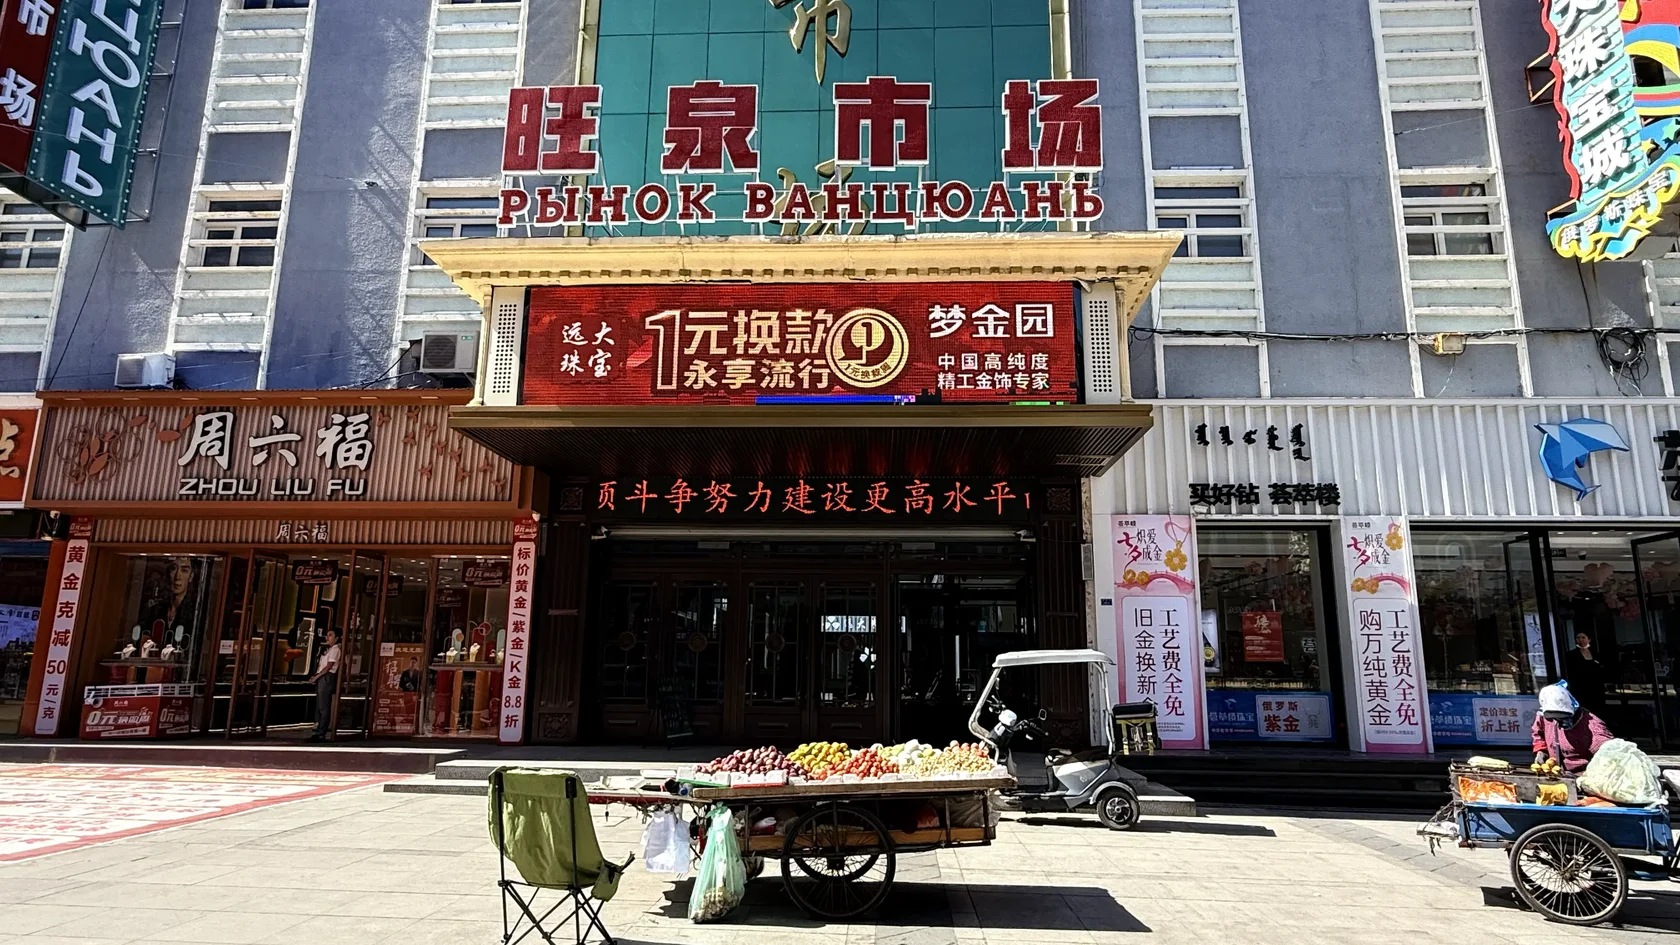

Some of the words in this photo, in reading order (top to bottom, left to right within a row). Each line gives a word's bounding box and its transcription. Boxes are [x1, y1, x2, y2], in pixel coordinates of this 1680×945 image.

[61, 0, 142, 197] ЦЮАНЬ
[500, 76, 1104, 175] 旺泉市场
[497, 182, 717, 228] РЫНОК
[743, 181, 1105, 229] ВАНЦЮАНЬ
[928, 303, 1054, 339] 梦金园
[683, 358, 831, 390] 永享流行
[937, 352, 1049, 372] 中国高纯度
[937, 372, 1051, 390] 精工金饰专家
[178, 411, 375, 472] 周六福
[179, 478, 258, 496] ZHOU
[270, 479, 314, 496] LIU
[326, 479, 366, 496] FU
[598, 479, 1031, 516] 斗争努力建设更高水平
[1188, 482, 1260, 506] 买好钻
[1267, 482, 1342, 507] 荟萃楼
[275, 522, 330, 542] 周六福
[1158, 608, 1186, 717] 工艺费全免
[1358, 608, 1392, 726] 购万纯黄金
[1386, 609, 1419, 726] 工艺费全免
[1262, 701, 1298, 712] 俄罗斯
[1479, 707, 1518, 717] 定价珠宝
[1264, 714, 1300, 733] 紫金
[1481, 719, 1520, 732] 折上折
